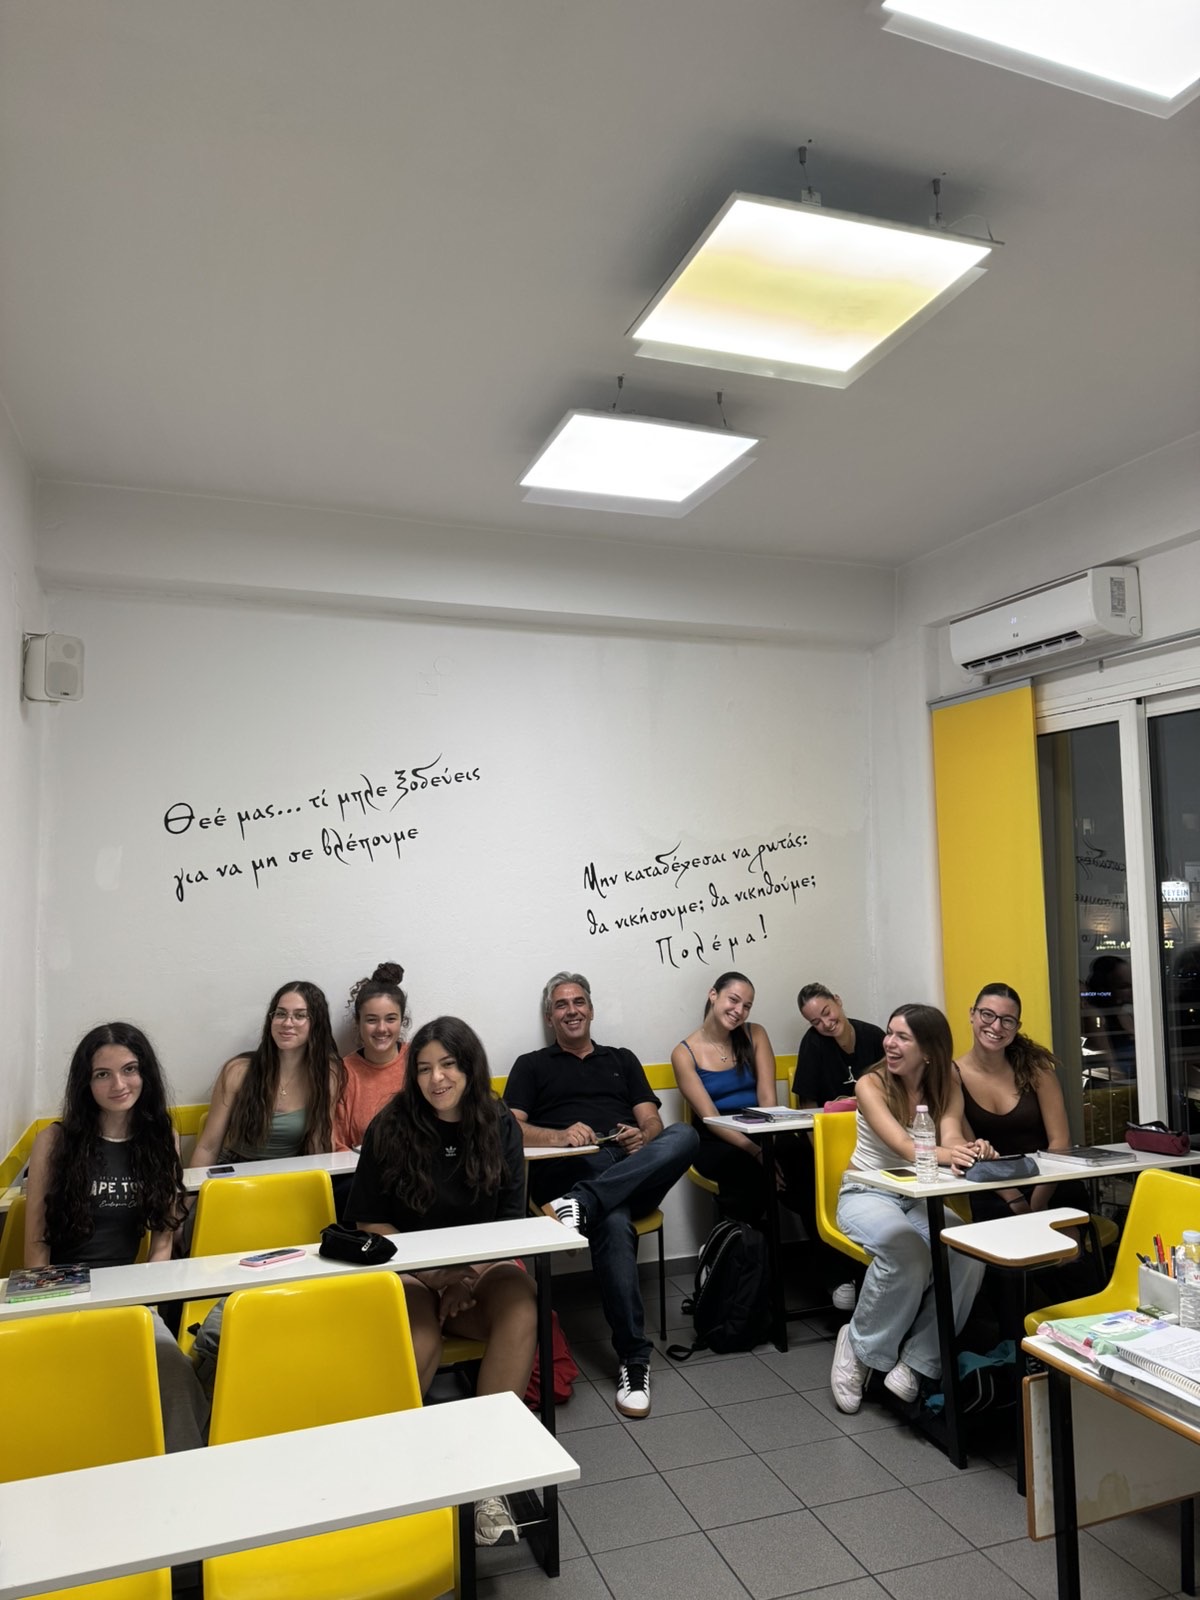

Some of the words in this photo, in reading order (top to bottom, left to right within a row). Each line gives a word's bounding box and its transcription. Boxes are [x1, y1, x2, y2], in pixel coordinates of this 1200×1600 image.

[164, 803, 228, 835] Θεέ
[237, 795, 302, 841] μας...
[338, 774, 388, 822] μπλε
[390, 753, 481, 812] ξοδεύεις
[173, 867, 209, 903] για
[216, 864, 244, 878] να
[250, 859, 278, 889] μη
[289, 849, 314, 864] σε
[322, 827, 419, 866] βλέπουμε
[584, 862, 619, 900] Μην
[625, 841, 727, 890] καταδέχεσαι
[732, 848, 751, 860] να
[748, 833, 808, 874] ρωτάς:
[587, 908, 610, 935] θα
[615, 900, 705, 931] νικήσουμε;
[709, 882, 730, 908] θα
[735, 871, 817, 905] νικηθούμε;
[656, 914, 768, 969] Πολέμα!
